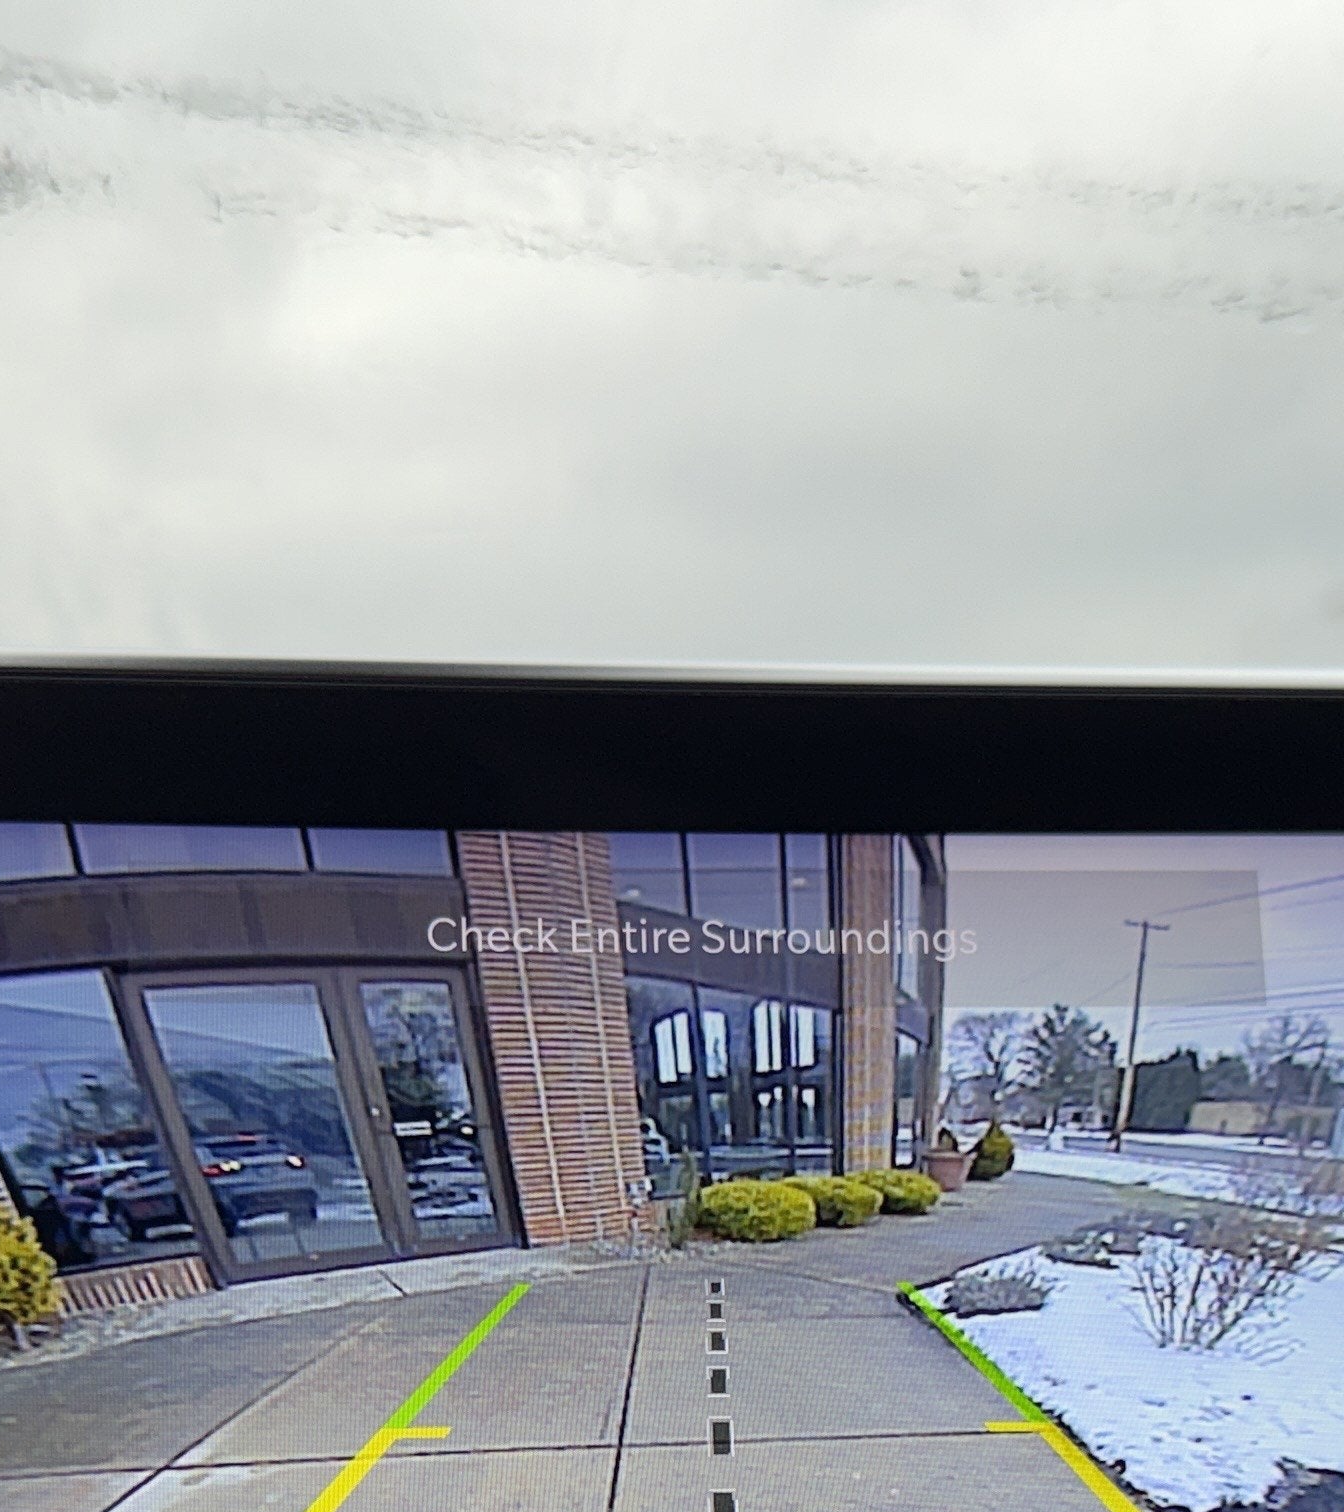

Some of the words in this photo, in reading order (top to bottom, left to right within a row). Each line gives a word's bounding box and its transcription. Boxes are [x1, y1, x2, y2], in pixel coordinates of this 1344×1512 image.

[427, 917, 558, 953] Check
[571, 918, 690, 954] Entire
[701, 920, 977, 962] Surroundings
